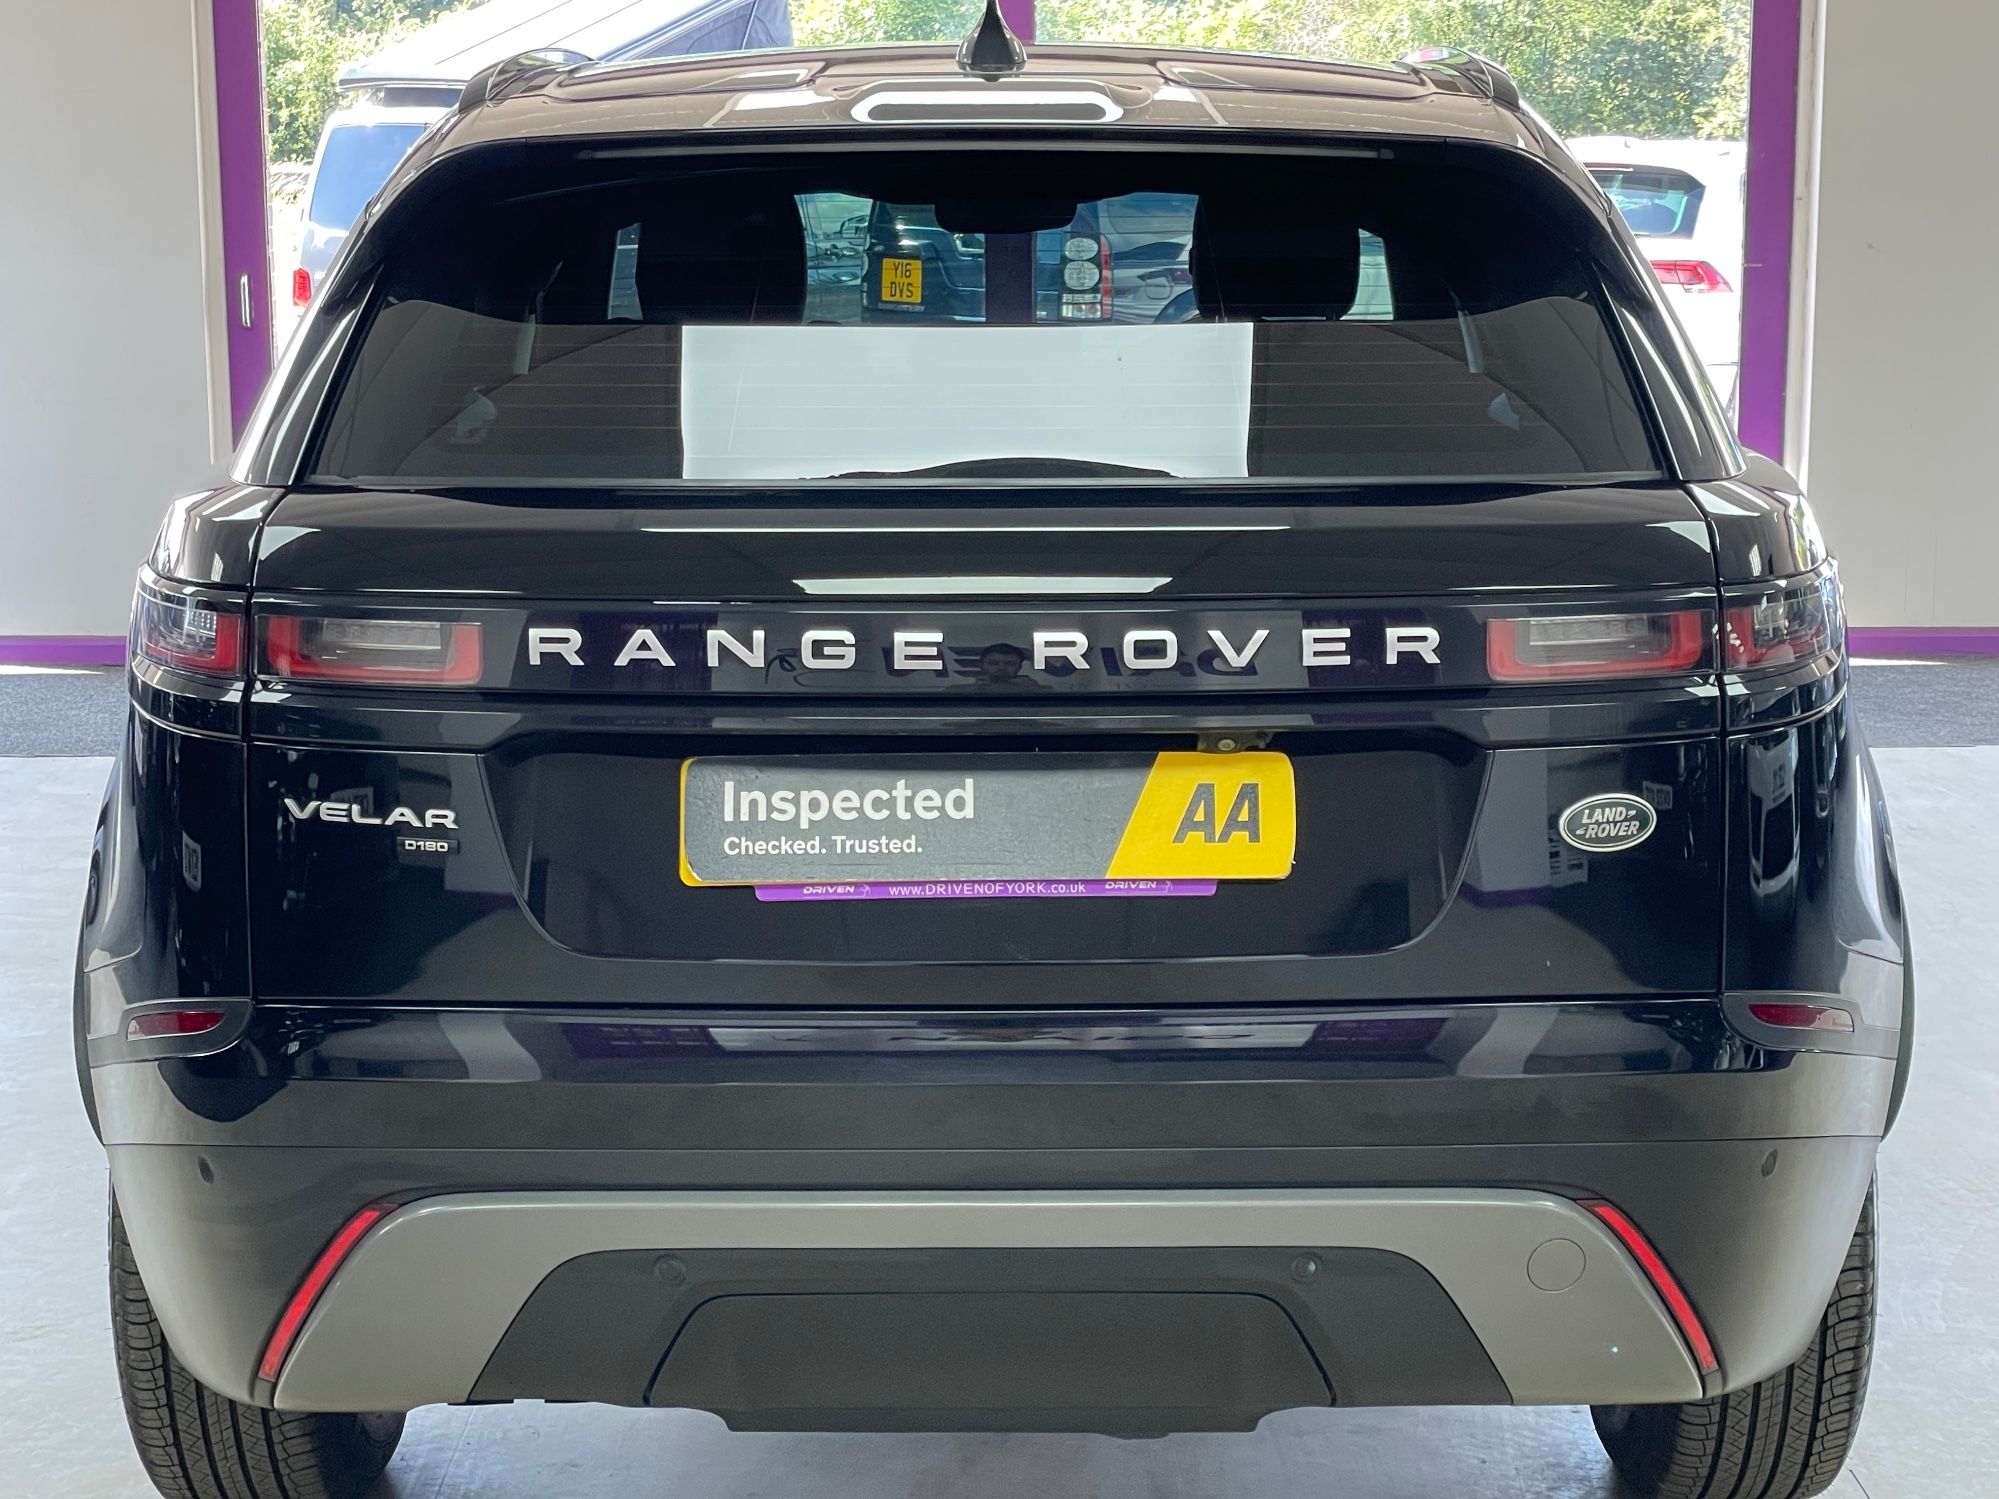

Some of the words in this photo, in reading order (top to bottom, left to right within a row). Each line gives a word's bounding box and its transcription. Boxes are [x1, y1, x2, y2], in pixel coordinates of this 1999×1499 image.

[893, 262, 912, 278] Y16
[890, 282, 913, 298] DVS
[528, 628, 944, 670] RANGE
[1033, 627, 1441, 670] ROVER
[284, 798, 459, 829] VELAR
[723, 778, 975, 830] Inspected
[1171, 782, 1263, 844] AA
[1581, 806, 1627, 824] LAND
[1585, 820, 1640, 839] ROVER
[404, 839, 449, 853] D180
[723, 835, 827, 856] Checked.
[831, 834, 923, 854] Trusted.
[803, 885, 855, 895] DRIVEN
[888, 881, 1087, 897] www.DRIVENOFYORK.co.uk
[1104, 880, 1157, 890] DRIVEN
